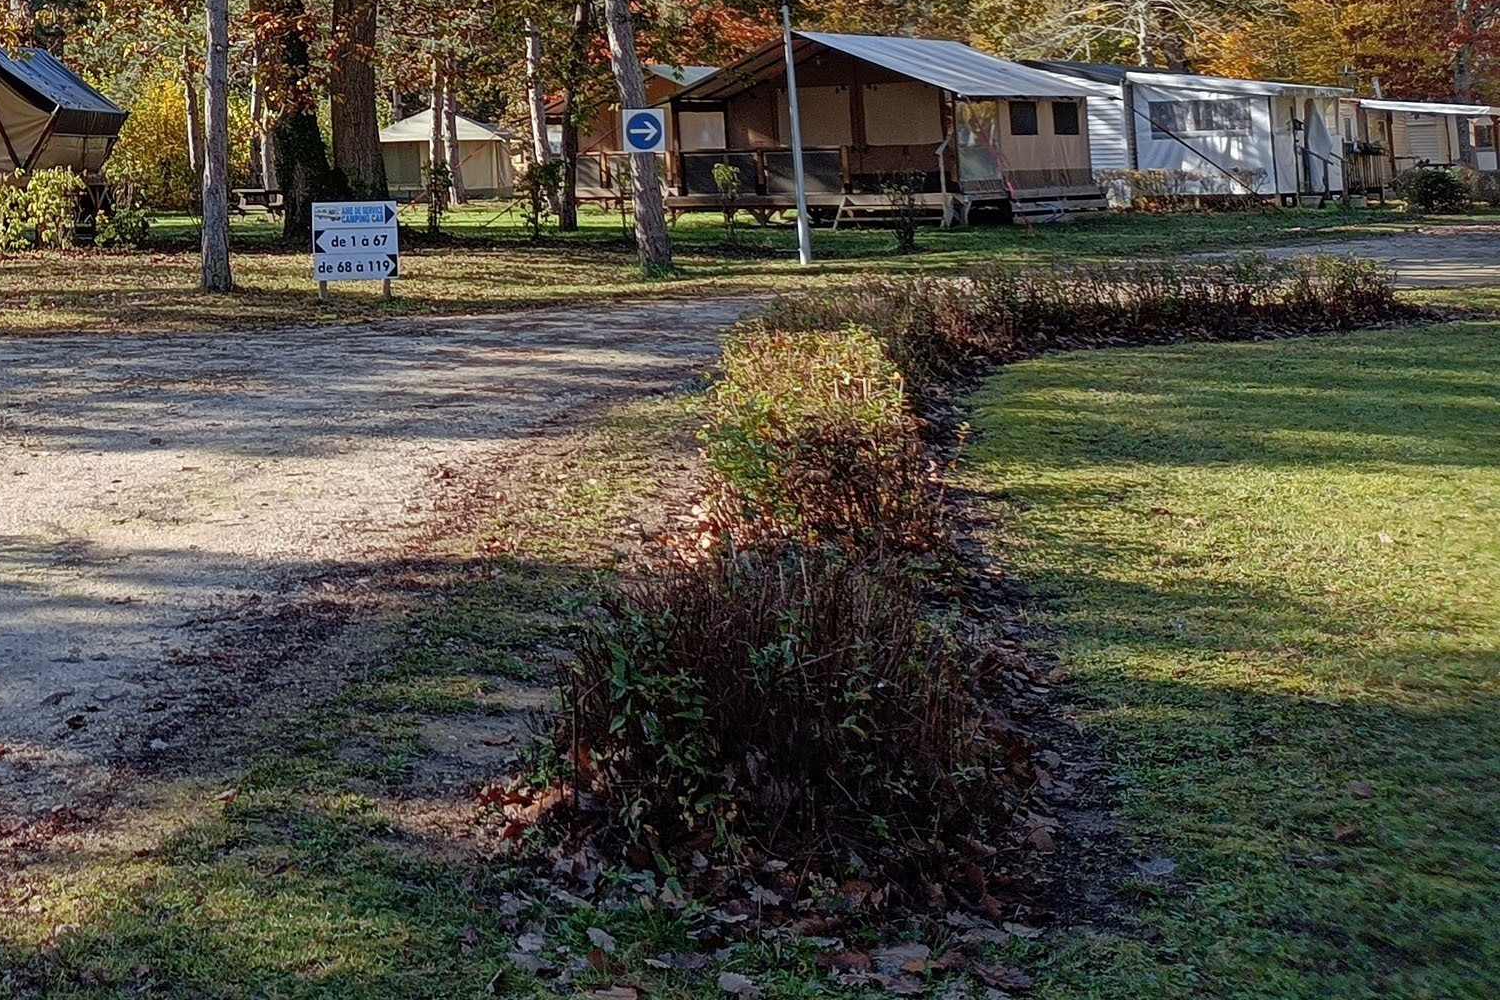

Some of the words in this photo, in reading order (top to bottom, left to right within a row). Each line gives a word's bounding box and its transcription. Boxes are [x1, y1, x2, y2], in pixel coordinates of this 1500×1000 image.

[354, 206, 362, 215] DE
[342, 214, 370, 223] CAMPING
[372, 214, 384, 223] CAR
[331, 235, 346, 247] de
[351, 236, 356, 247] 1
[361, 235, 369, 247] à
[373, 235, 388, 246] 67
[318, 261, 333, 273] de
[337, 261, 352, 272] 68
[356, 260, 364, 272] à
[368, 260, 390, 271] 119
